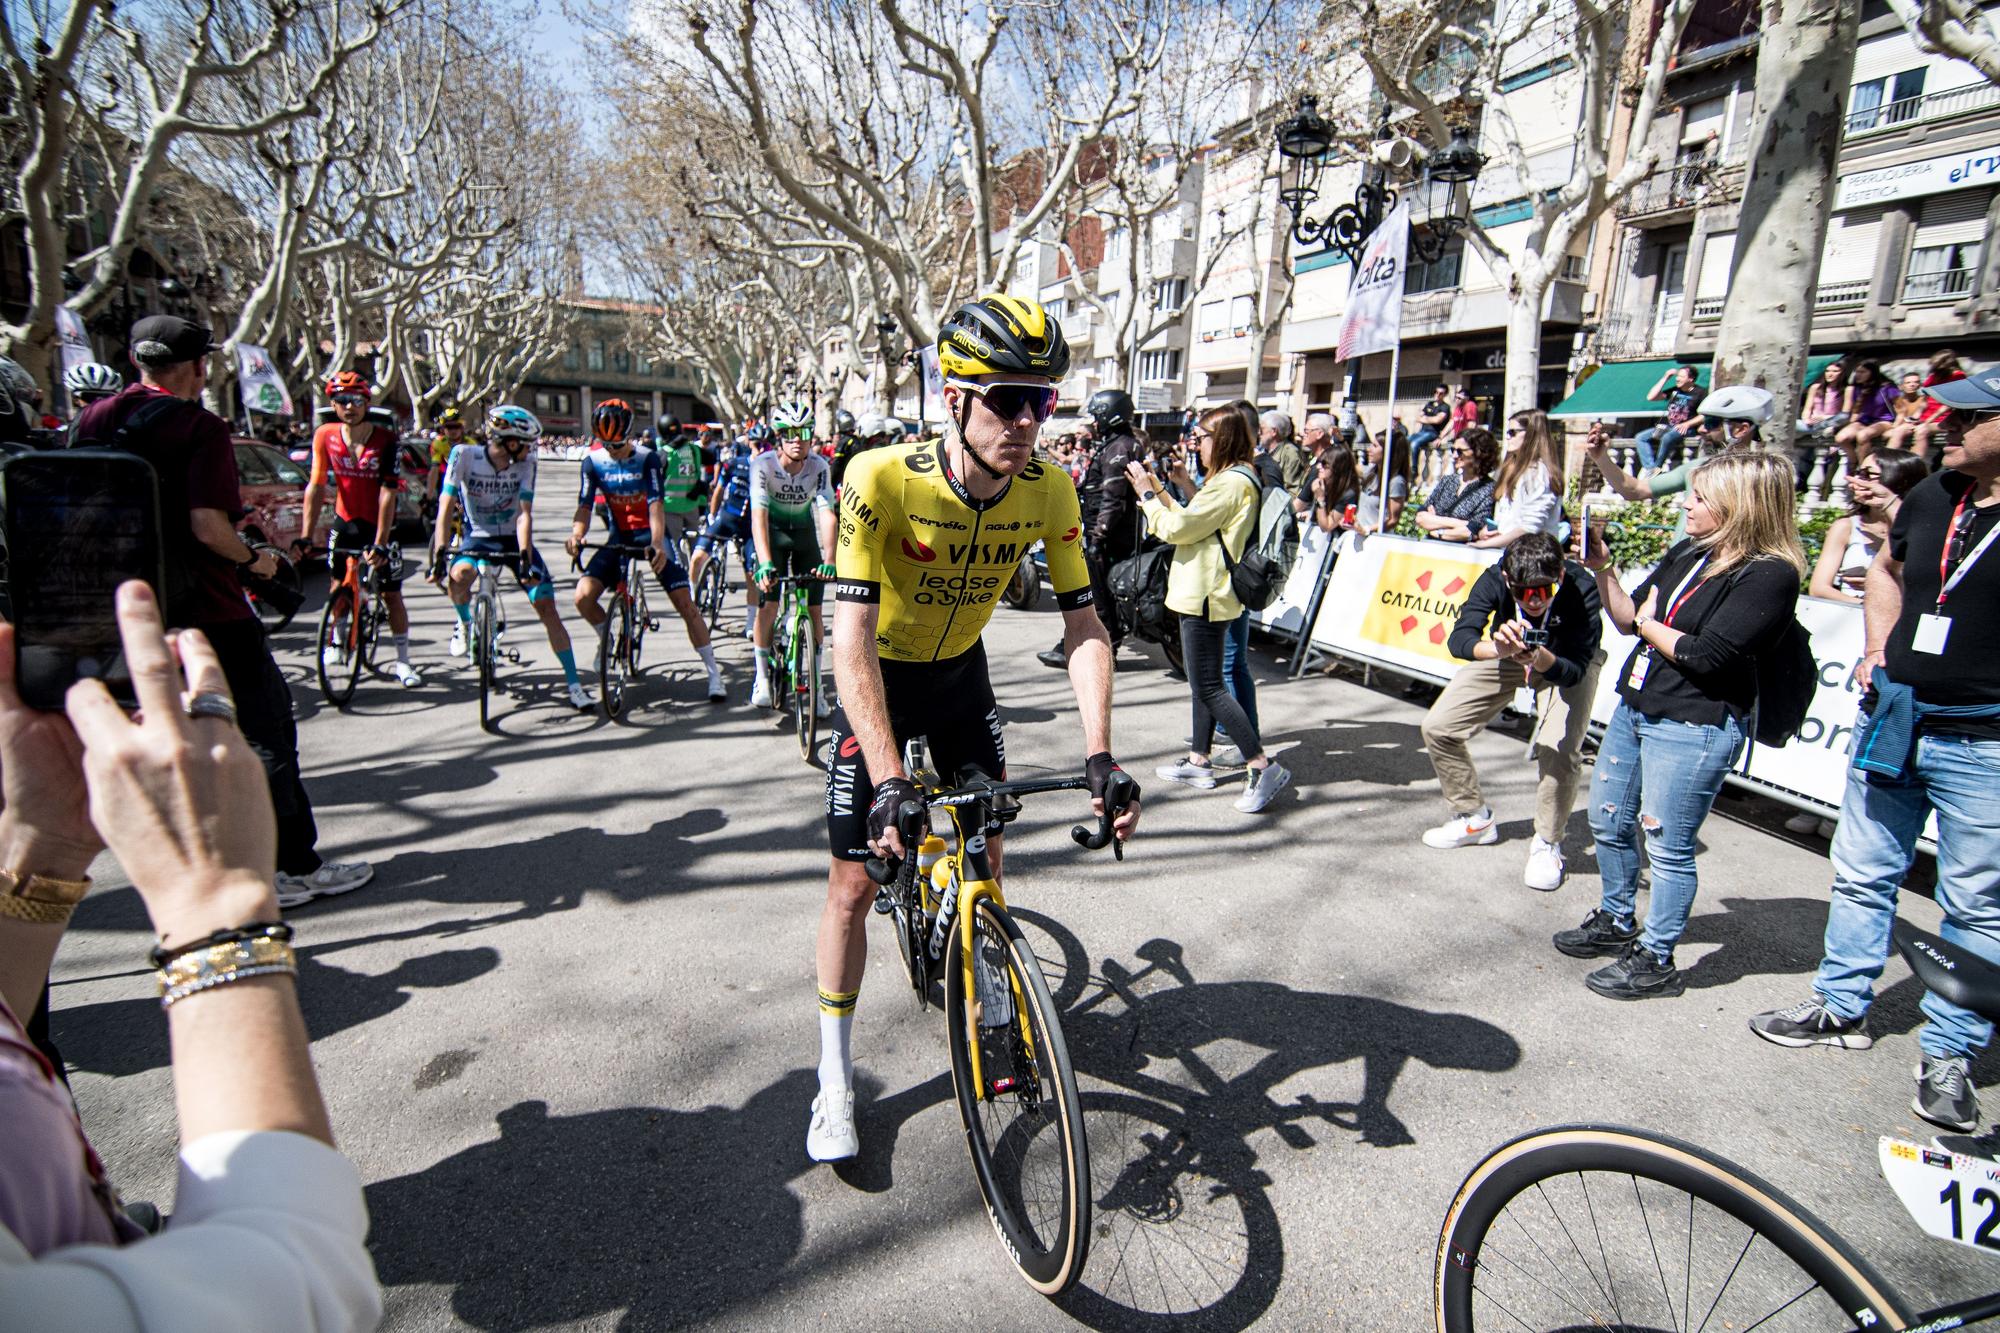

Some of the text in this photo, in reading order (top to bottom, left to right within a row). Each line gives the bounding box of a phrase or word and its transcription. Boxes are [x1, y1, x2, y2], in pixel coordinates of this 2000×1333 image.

[1849, 164, 1933, 186] PERRUQUERIA
[1949, 159, 1972, 183] el
[953, 329, 990, 359] GIRO
[775, 493, 809, 501] RURAL
[842, 482, 880, 532] VISMA
[909, 514, 968, 531] cervélo
[948, 542, 1031, 565] VISMA
[837, 584, 870, 596] AM
[918, 571, 1000, 590] lease
[1077, 590, 1094, 604] SR
[1381, 590, 1462, 619] CATALUN
[833, 764, 857, 816] VISMA
